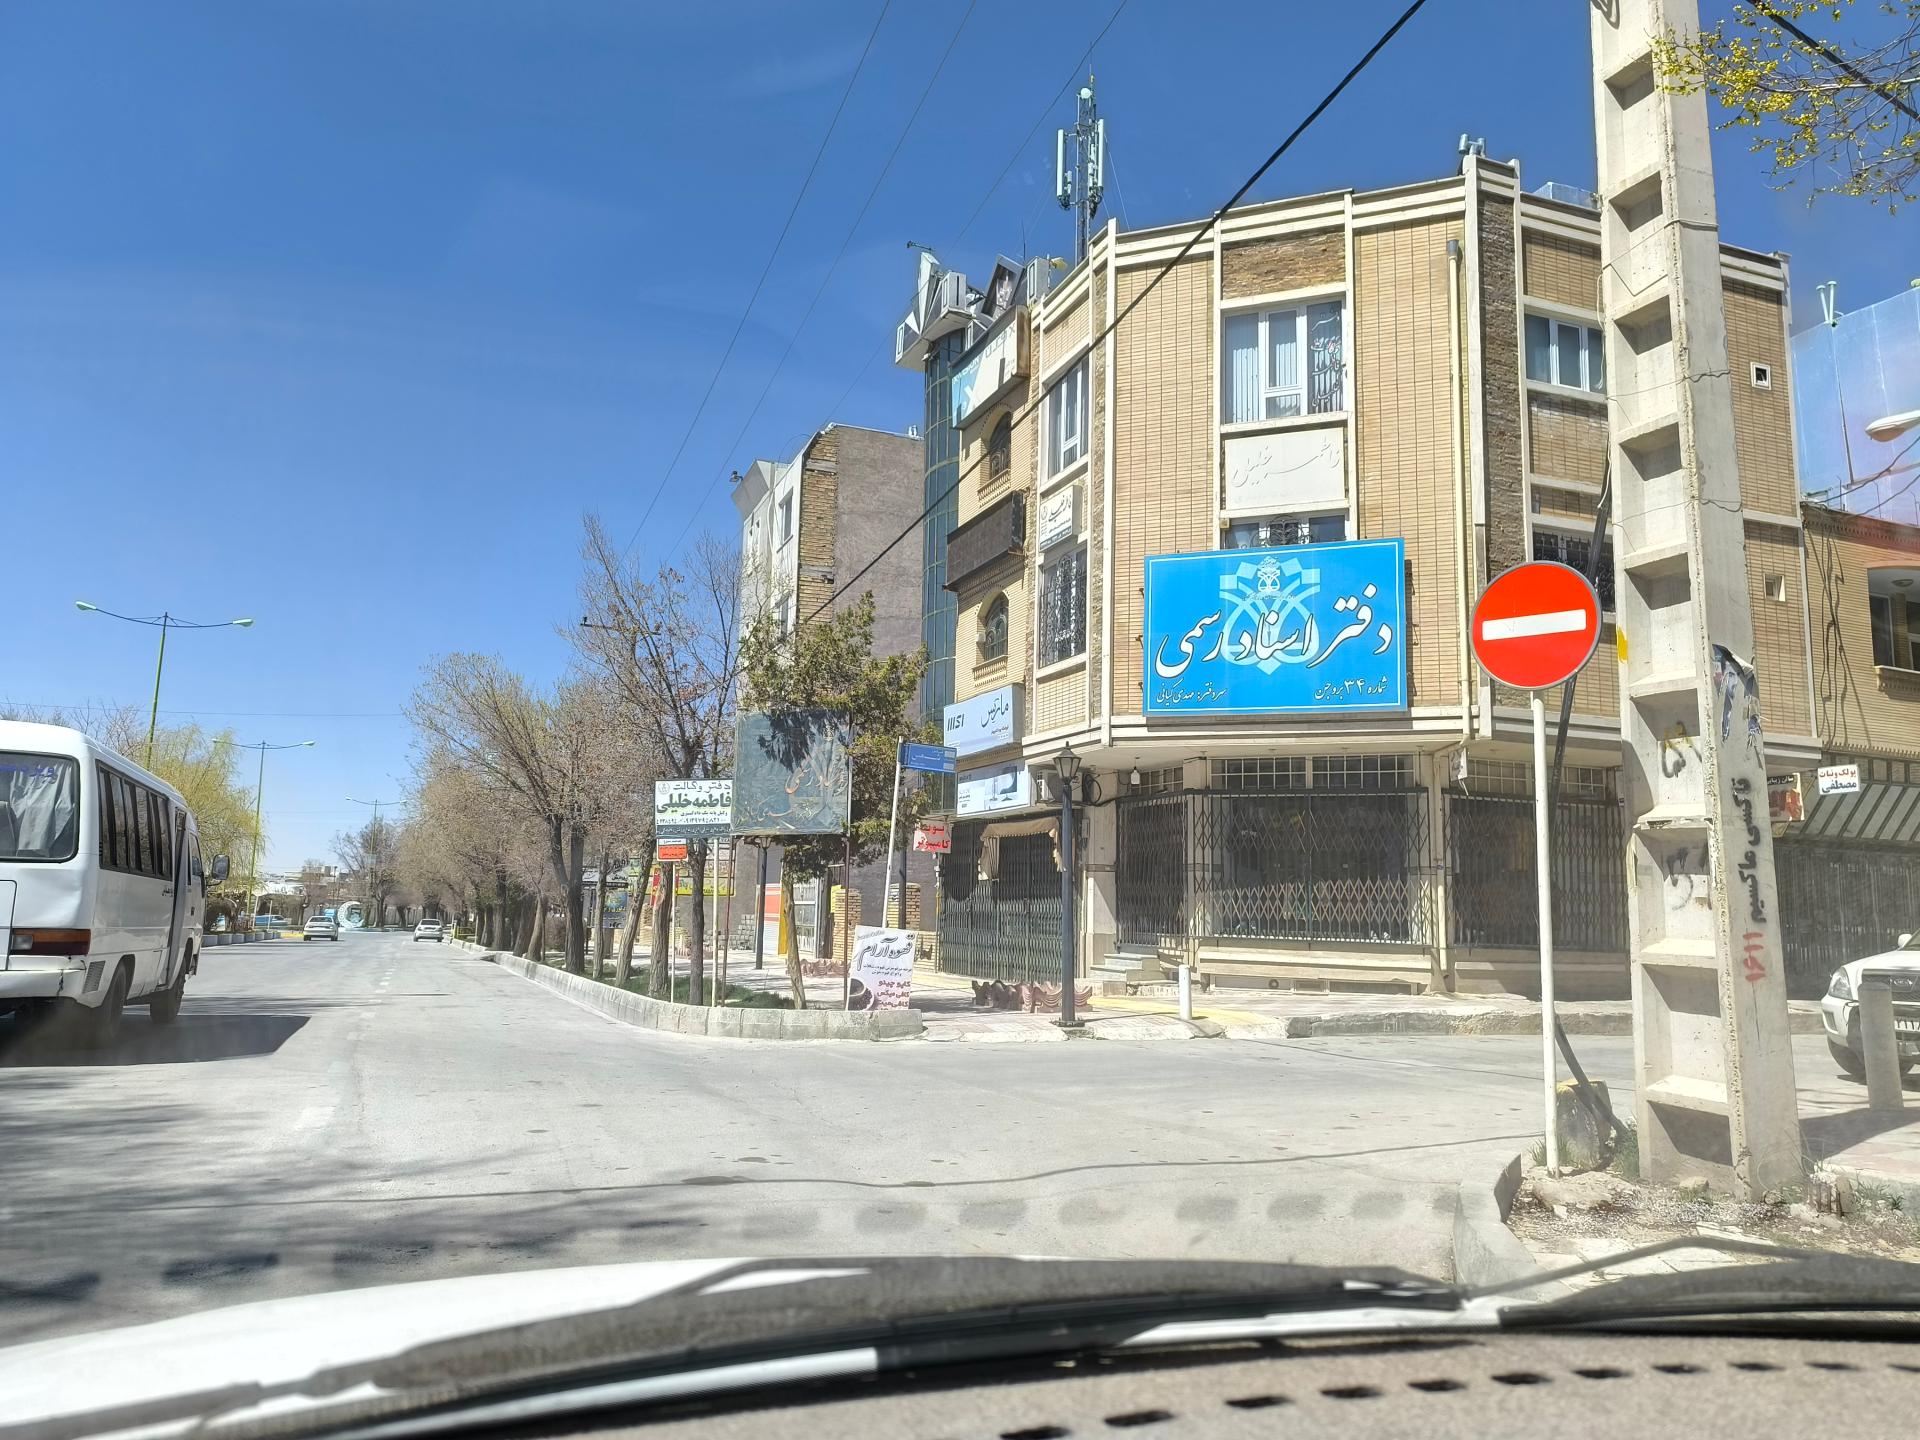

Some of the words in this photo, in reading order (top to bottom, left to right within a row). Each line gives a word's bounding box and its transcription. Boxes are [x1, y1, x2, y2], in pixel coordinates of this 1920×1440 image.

[1231, 445, 1273, 488] خلیلی
[1235, 609, 1314, 662] اسناد
[1306, 582, 1393, 669] دفتر
[1154, 608, 1225, 679] رسمی
[1156, 677, 1185, 706] کیانی
[1314, 682, 1344, 700] بروجن
[1344, 678, 1365, 695] ۳۴
[1367, 675, 1388, 694] شماره
[1172, 689, 1195, 704] مهدی
[673, 780, 703, 793] وکالت
[703, 780, 731, 794] دفتر
[1821, 779, 1858, 794] مصطفی
[656, 792, 692, 814] خلیلی
[692, 791, 732, 808] فاطمه
[1731, 777, 1761, 847] تاکسی
[1737, 850, 1767, 924] ماکسیم
[856, 936, 899, 972] آرام
[888, 933, 916, 960] قهوه
[878, 980, 895, 988] چینو
[895, 981, 911, 989] کاپو
